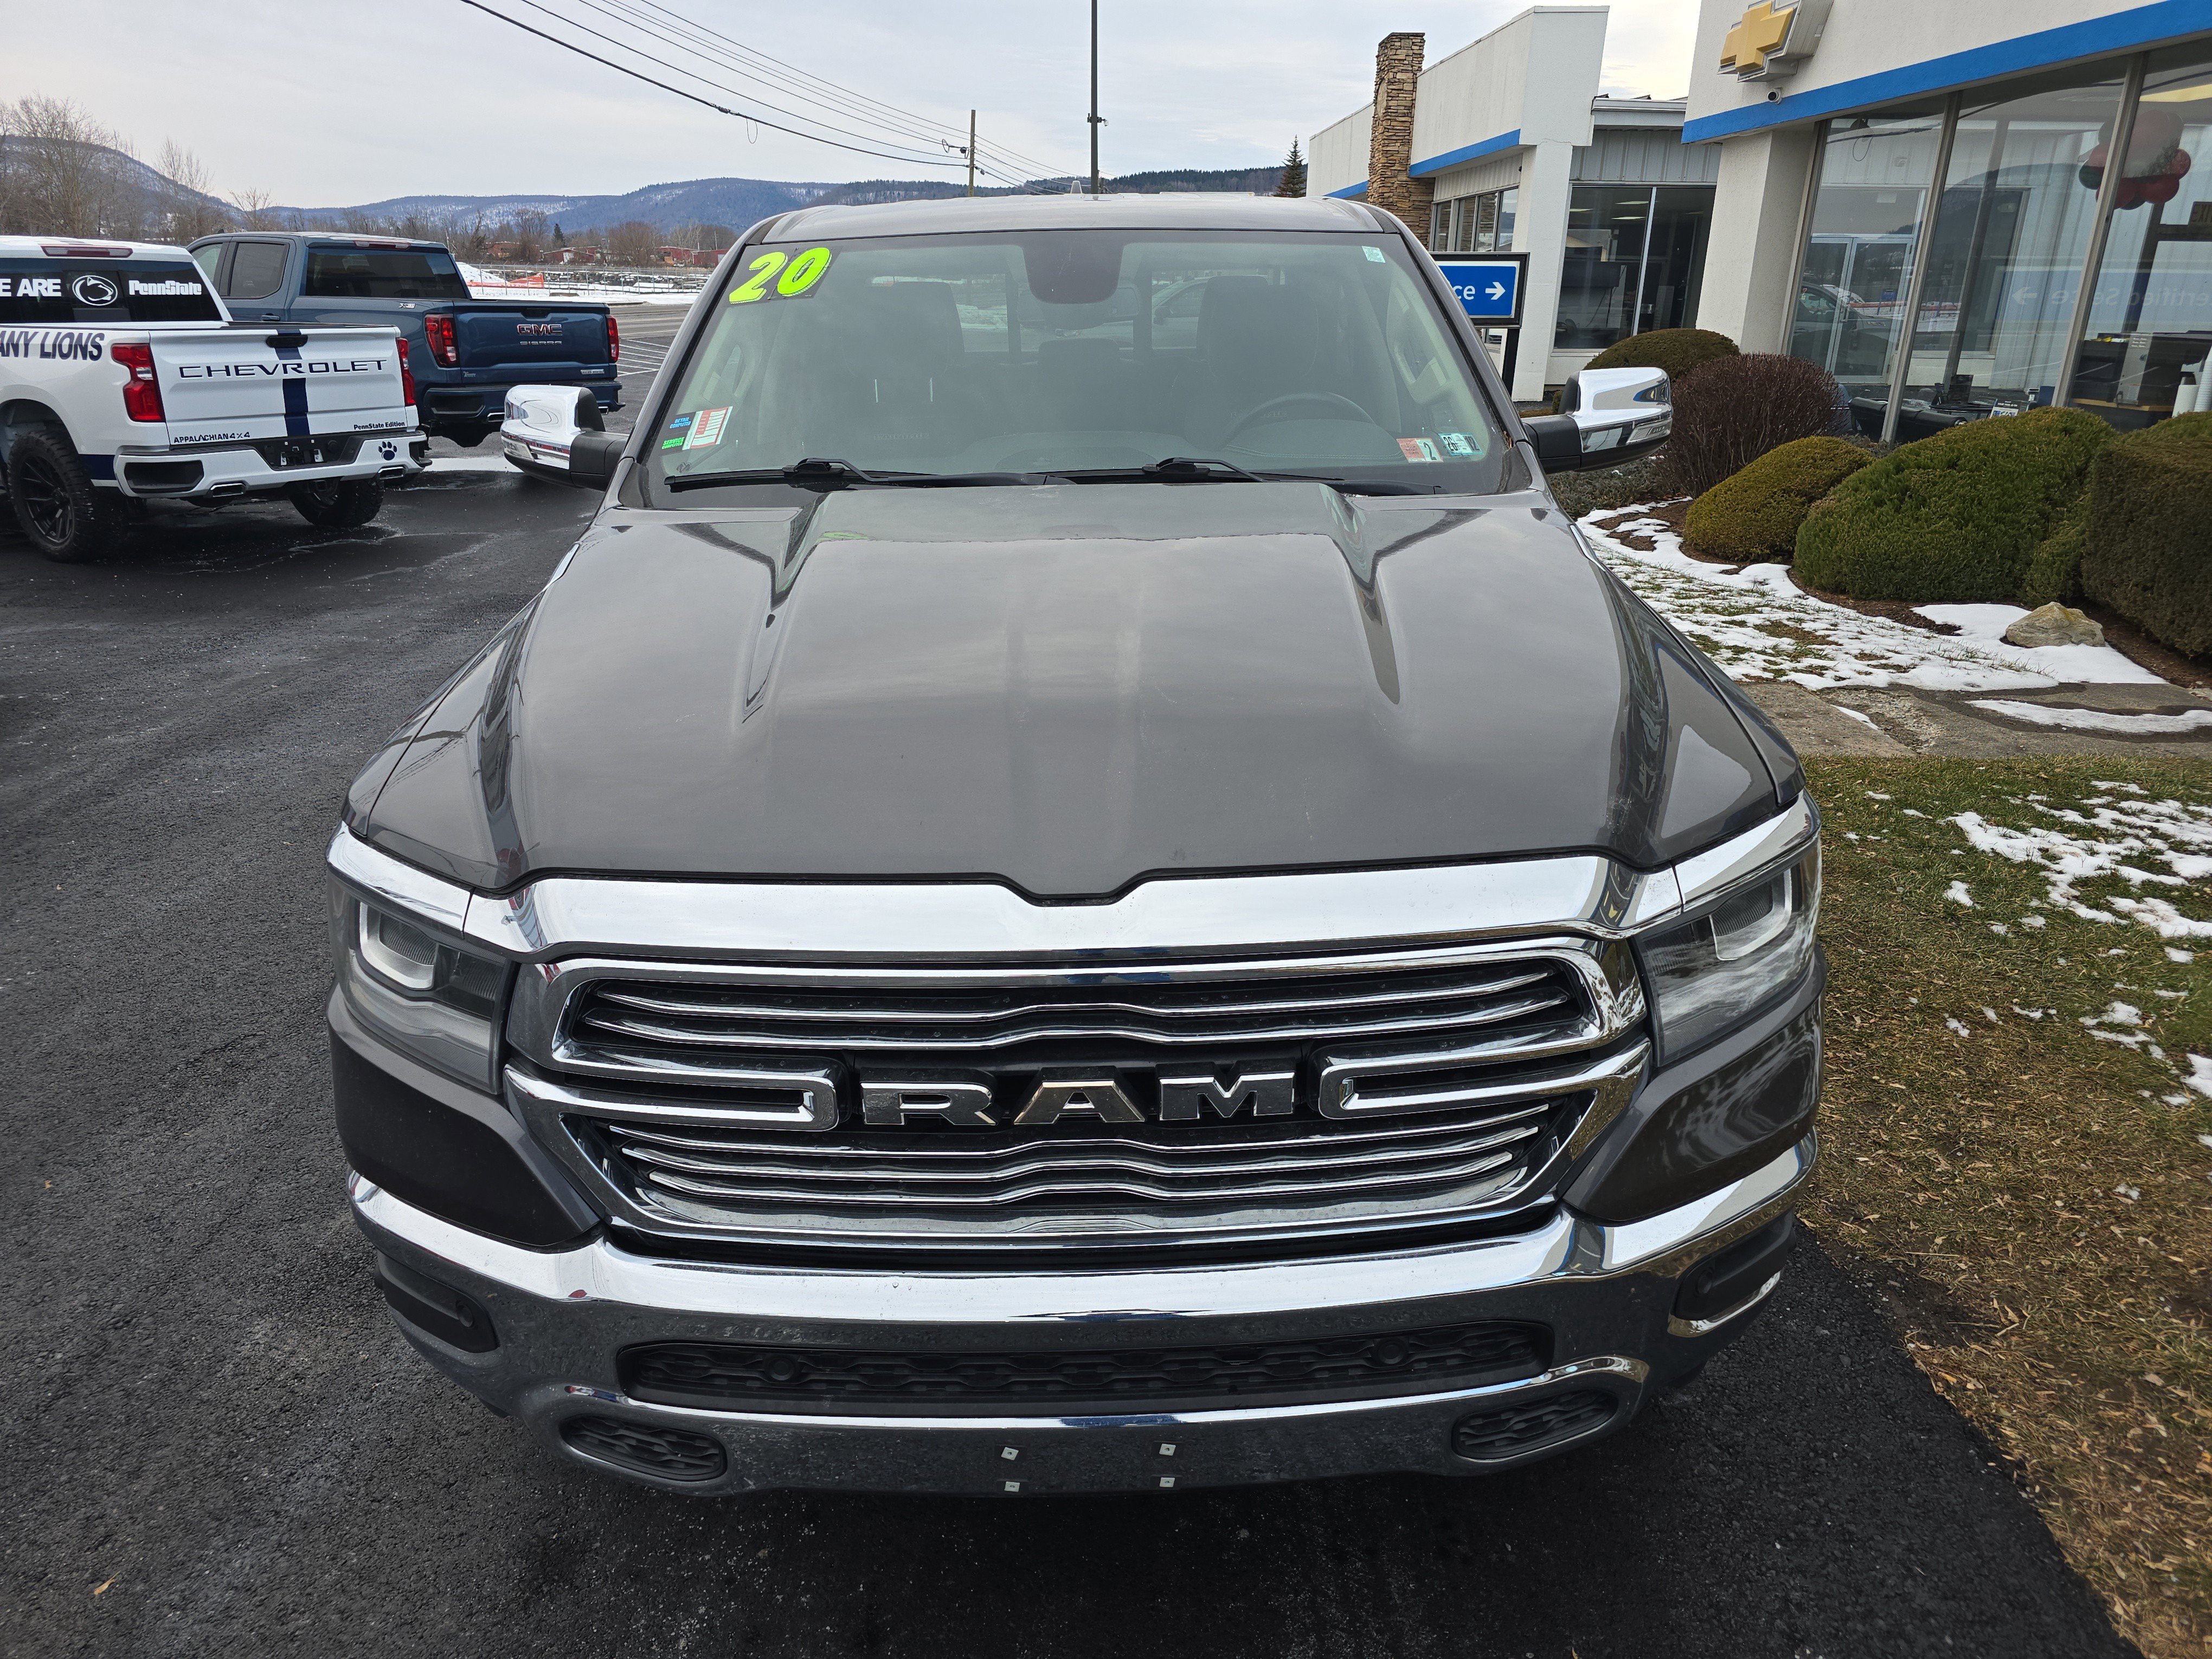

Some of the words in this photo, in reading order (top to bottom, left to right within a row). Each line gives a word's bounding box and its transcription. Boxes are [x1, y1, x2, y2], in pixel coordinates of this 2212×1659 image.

[729, 247, 832, 304] 20
[17, 279, 61, 297] ARE
[128, 280, 202, 295] PennState
[517, 324, 563, 336] GMC
[40, 331, 105, 361] LIONS
[179, 359, 387, 378] CHEVROLET
[174, 434, 228, 443] APPALACHIAN
[1423, 442, 1437, 461] 2
[860, 1070, 1296, 1126] RAM
